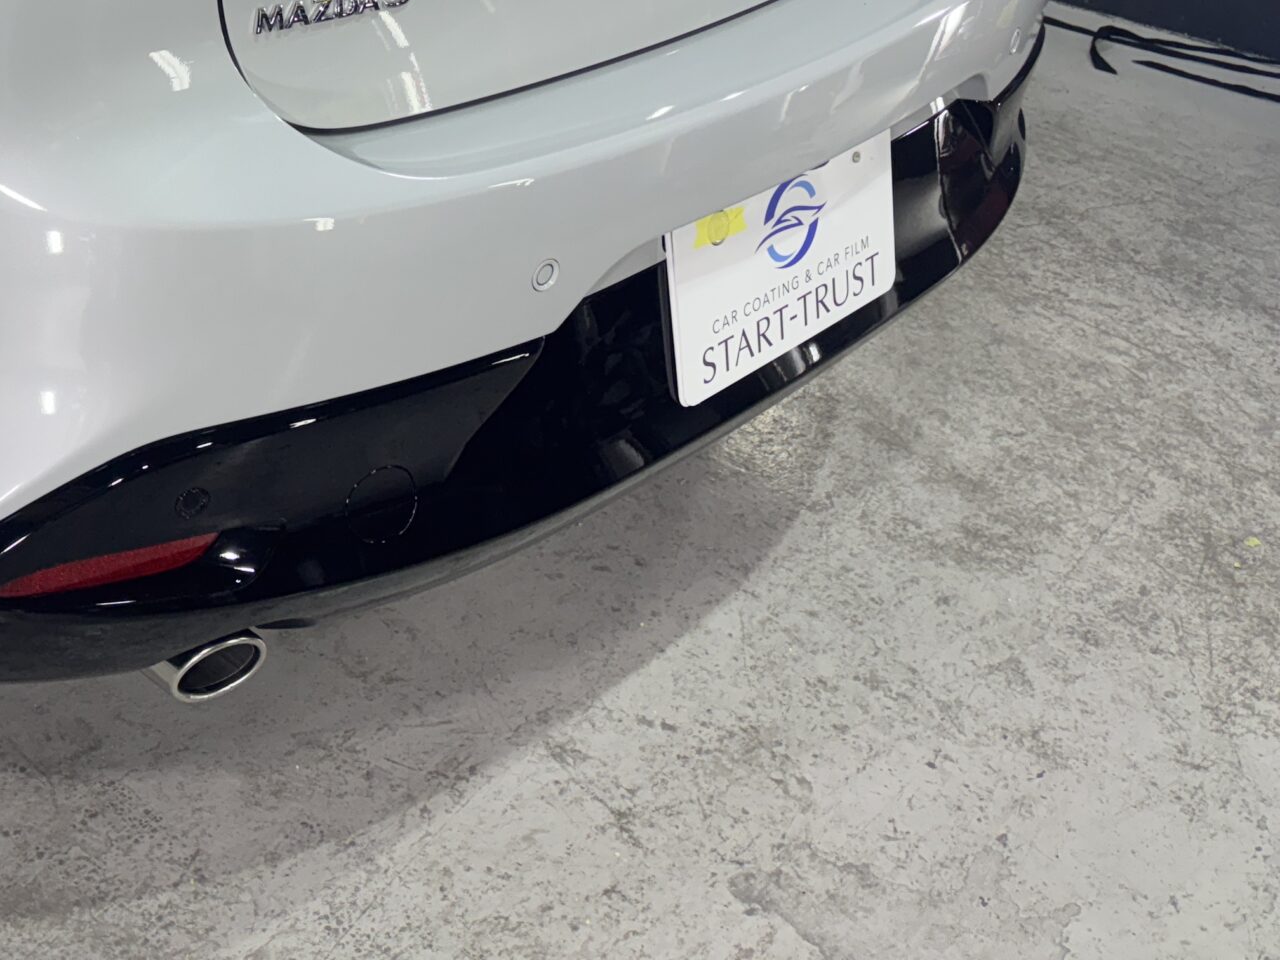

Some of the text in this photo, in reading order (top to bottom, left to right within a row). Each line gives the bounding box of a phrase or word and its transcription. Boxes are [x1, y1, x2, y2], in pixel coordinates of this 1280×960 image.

[702, 253, 879, 384] START-TRUST
[712, 236, 869, 334] CAR COATING & CAR FILM
